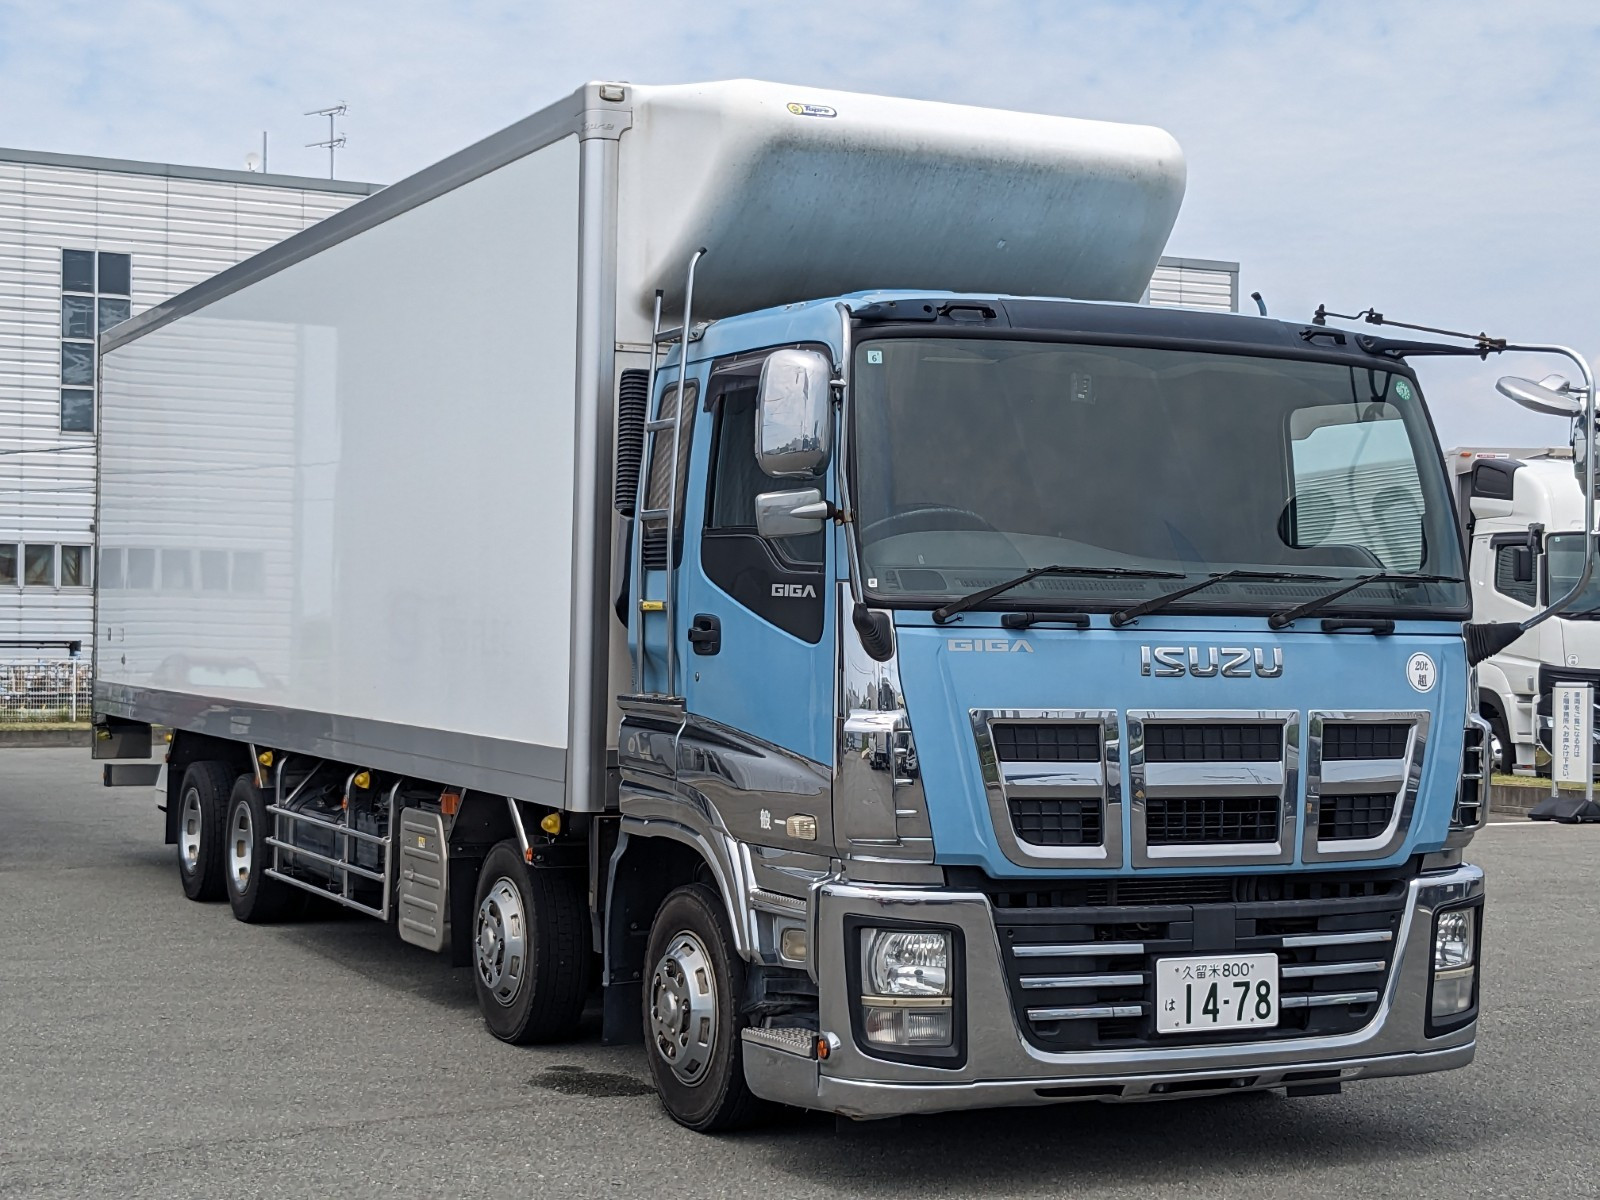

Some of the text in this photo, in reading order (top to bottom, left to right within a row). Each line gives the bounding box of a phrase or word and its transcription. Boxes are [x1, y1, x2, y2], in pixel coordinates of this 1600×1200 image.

[771, 583, 817, 598] GIGA
[947, 638, 1035, 653] GIGA
[1141, 646, 1283, 678] ISUZU
[1414, 660, 1429, 671] 20t
[1417, 673, 1428, 687] 超
[1164, 979, 1272, 1025] は 14-78
